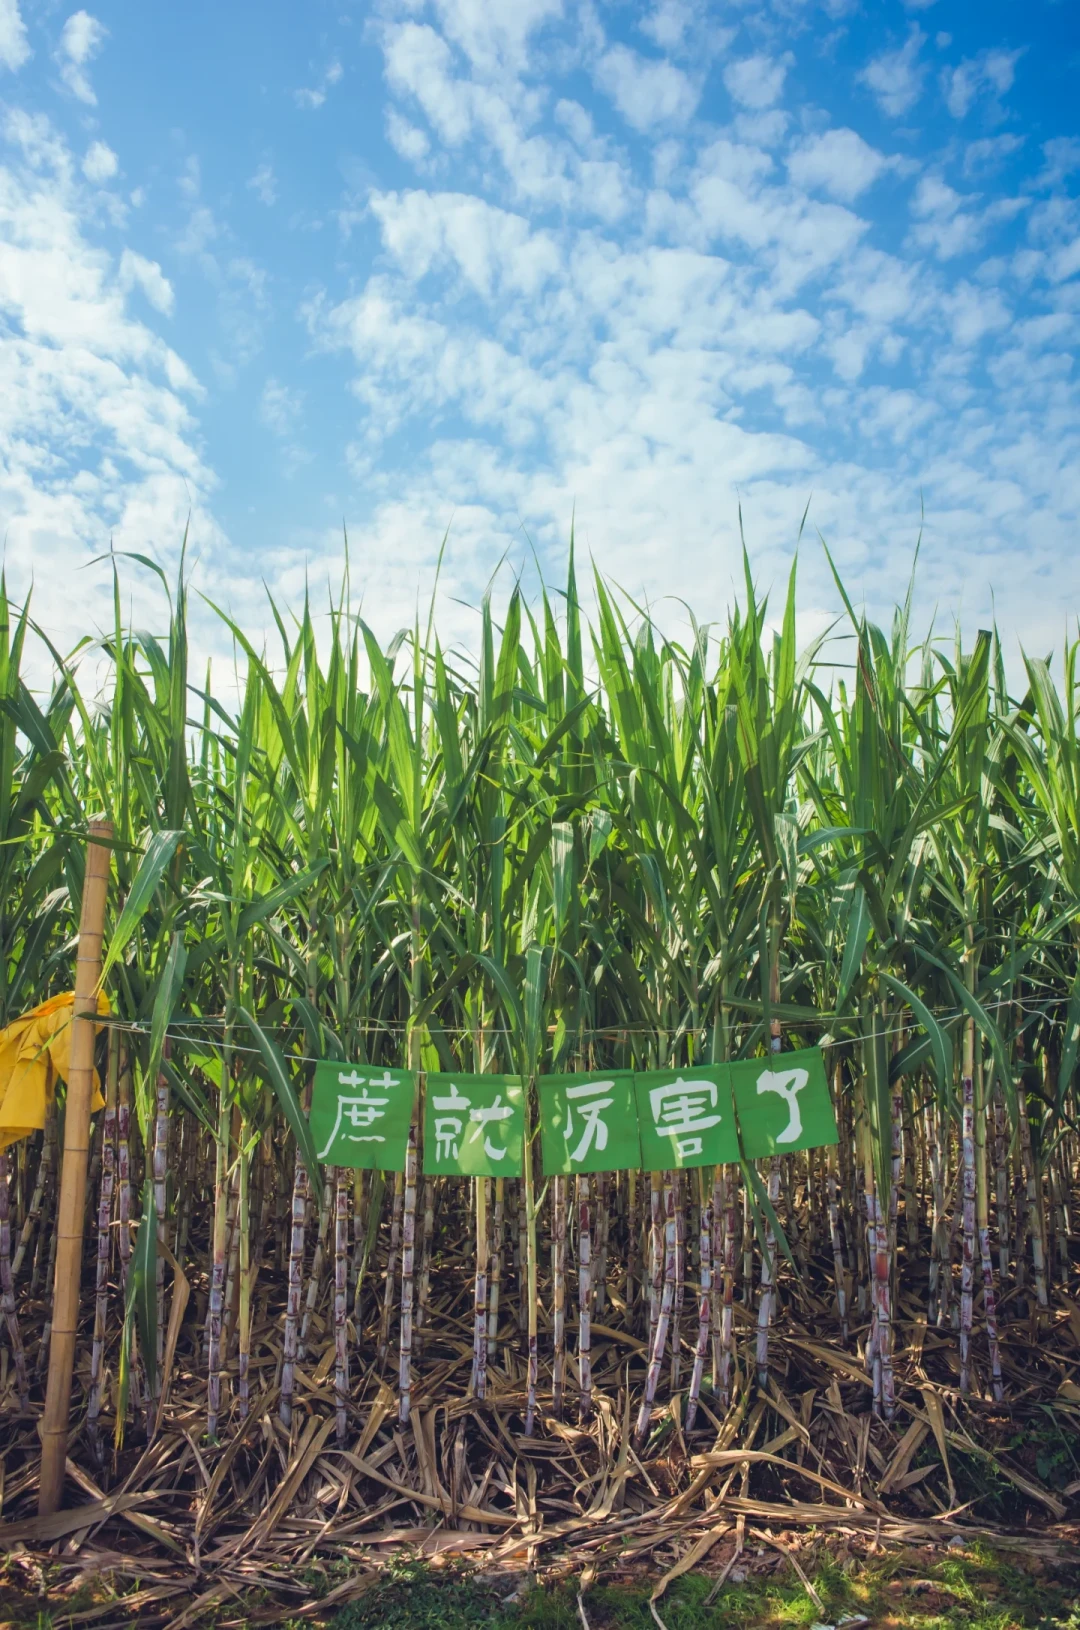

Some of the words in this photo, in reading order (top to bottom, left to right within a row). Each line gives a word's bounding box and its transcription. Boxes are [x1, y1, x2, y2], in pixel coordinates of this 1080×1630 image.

[317, 1068, 809, 1163] 蔗就厉害了
